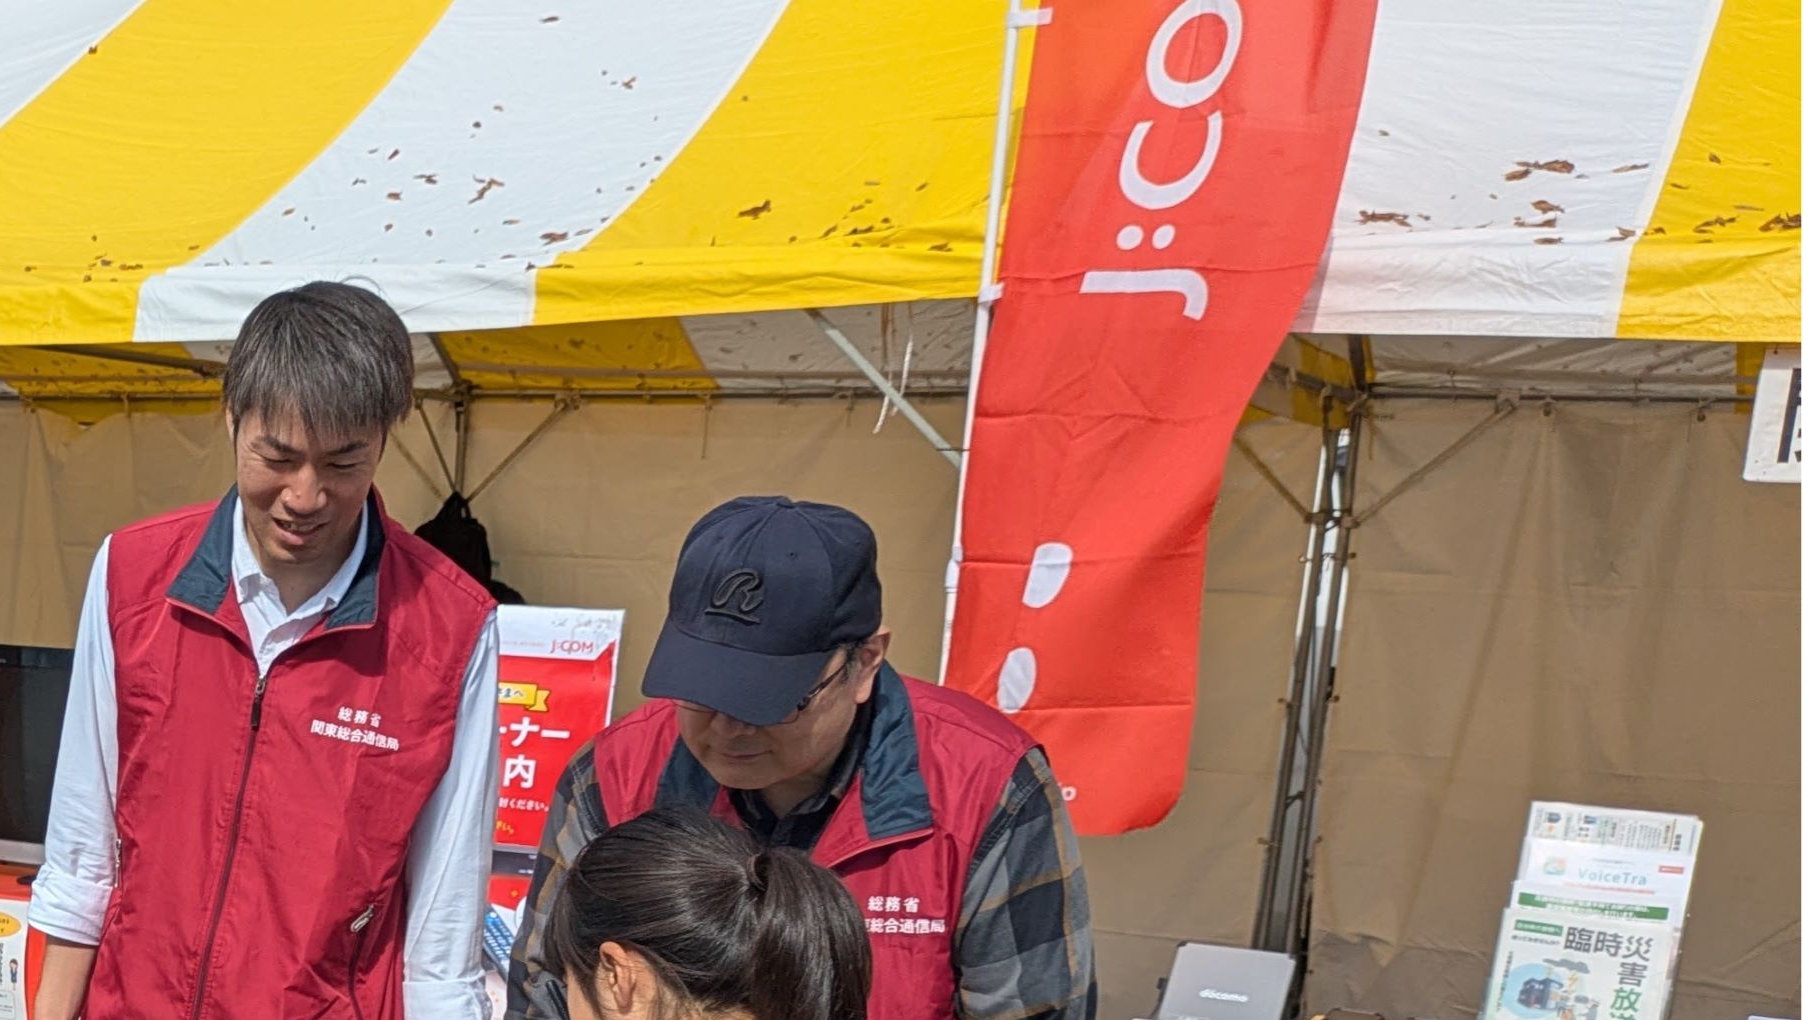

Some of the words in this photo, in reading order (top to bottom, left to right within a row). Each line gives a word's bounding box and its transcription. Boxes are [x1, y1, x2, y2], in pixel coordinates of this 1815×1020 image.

[550, 639, 594, 654] J:COM
[337, 706, 382, 728] 総務省
[310, 719, 400, 751] 関東総合通信局
[499, 716, 571, 747] ナー
[503, 754, 537, 789] 内
[1578, 867, 1647, 886] VoiceTra
[867, 896, 920, 913] 総務省
[1199, 988, 1249, 1003] docomo
